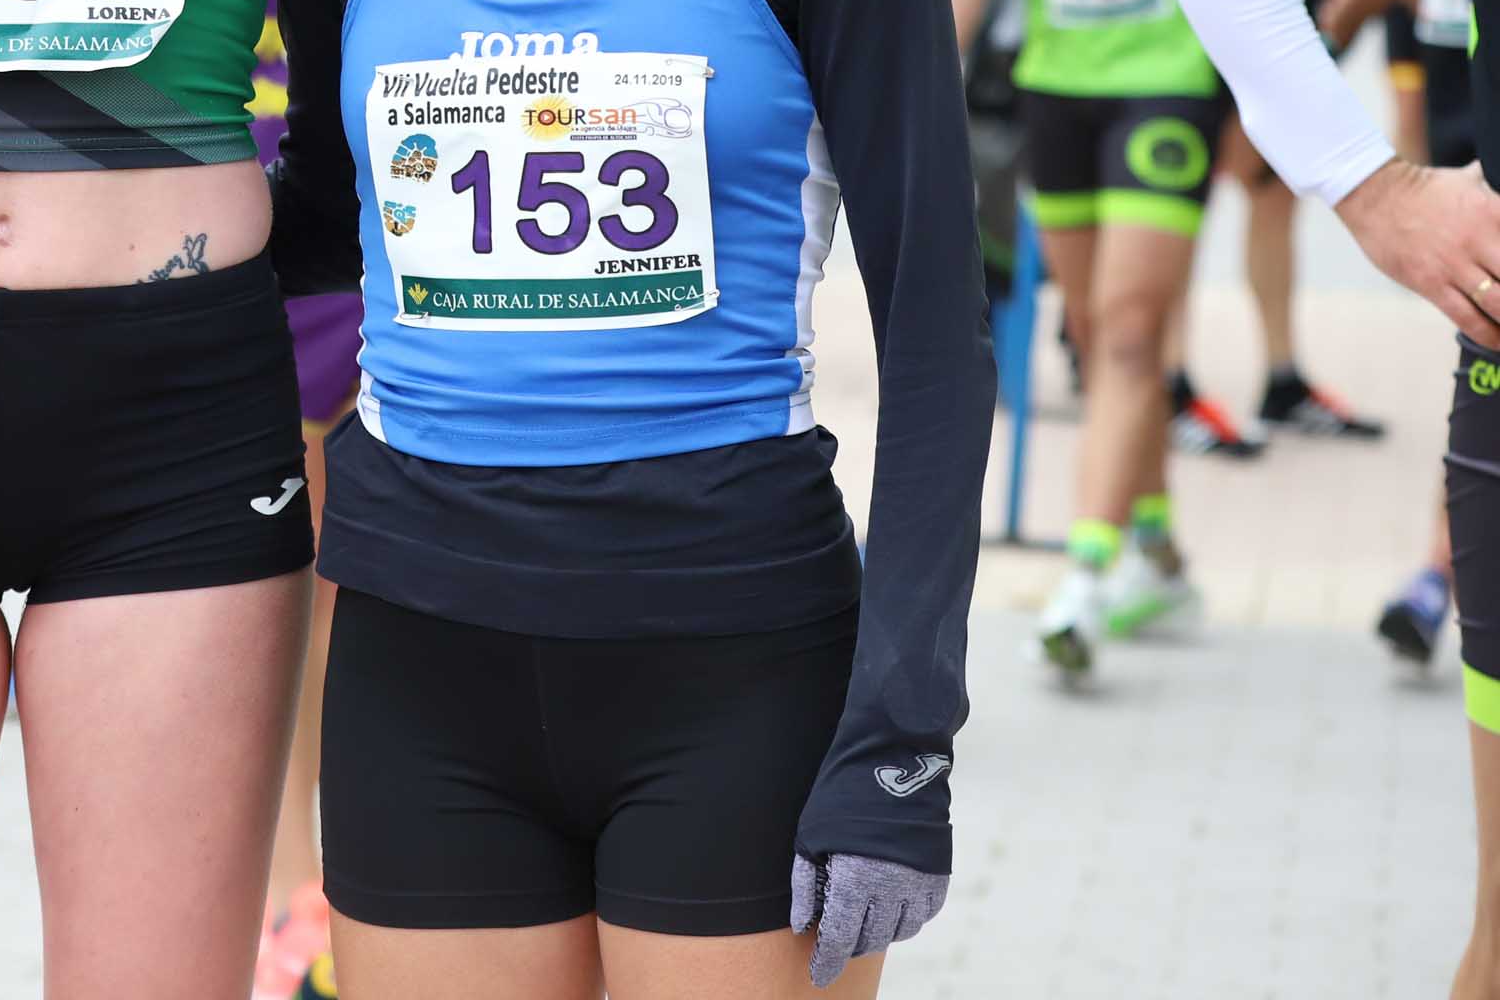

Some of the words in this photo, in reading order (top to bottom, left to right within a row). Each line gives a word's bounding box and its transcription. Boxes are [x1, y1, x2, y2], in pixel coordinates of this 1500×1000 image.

[88, 6, 171, 21] LORENA
[7, 37, 34, 52] DE
[38, 35, 155, 52] SALAMANC
[414, 69, 478, 97] Vuelta
[486, 65, 580, 96] Pedestre
[614, 73, 683, 87] 24.11.2019
[388, 108, 398, 126] a
[404, 101, 506, 126] Salamanca
[451, 150, 679, 255] 153
[594, 254, 702, 275] JENNIFER
[432, 290, 469, 310] CAJA
[473, 292, 535, 310] RURAL
[539, 293, 564, 308] DE
[568, 285, 700, 309] SALAMANCA
